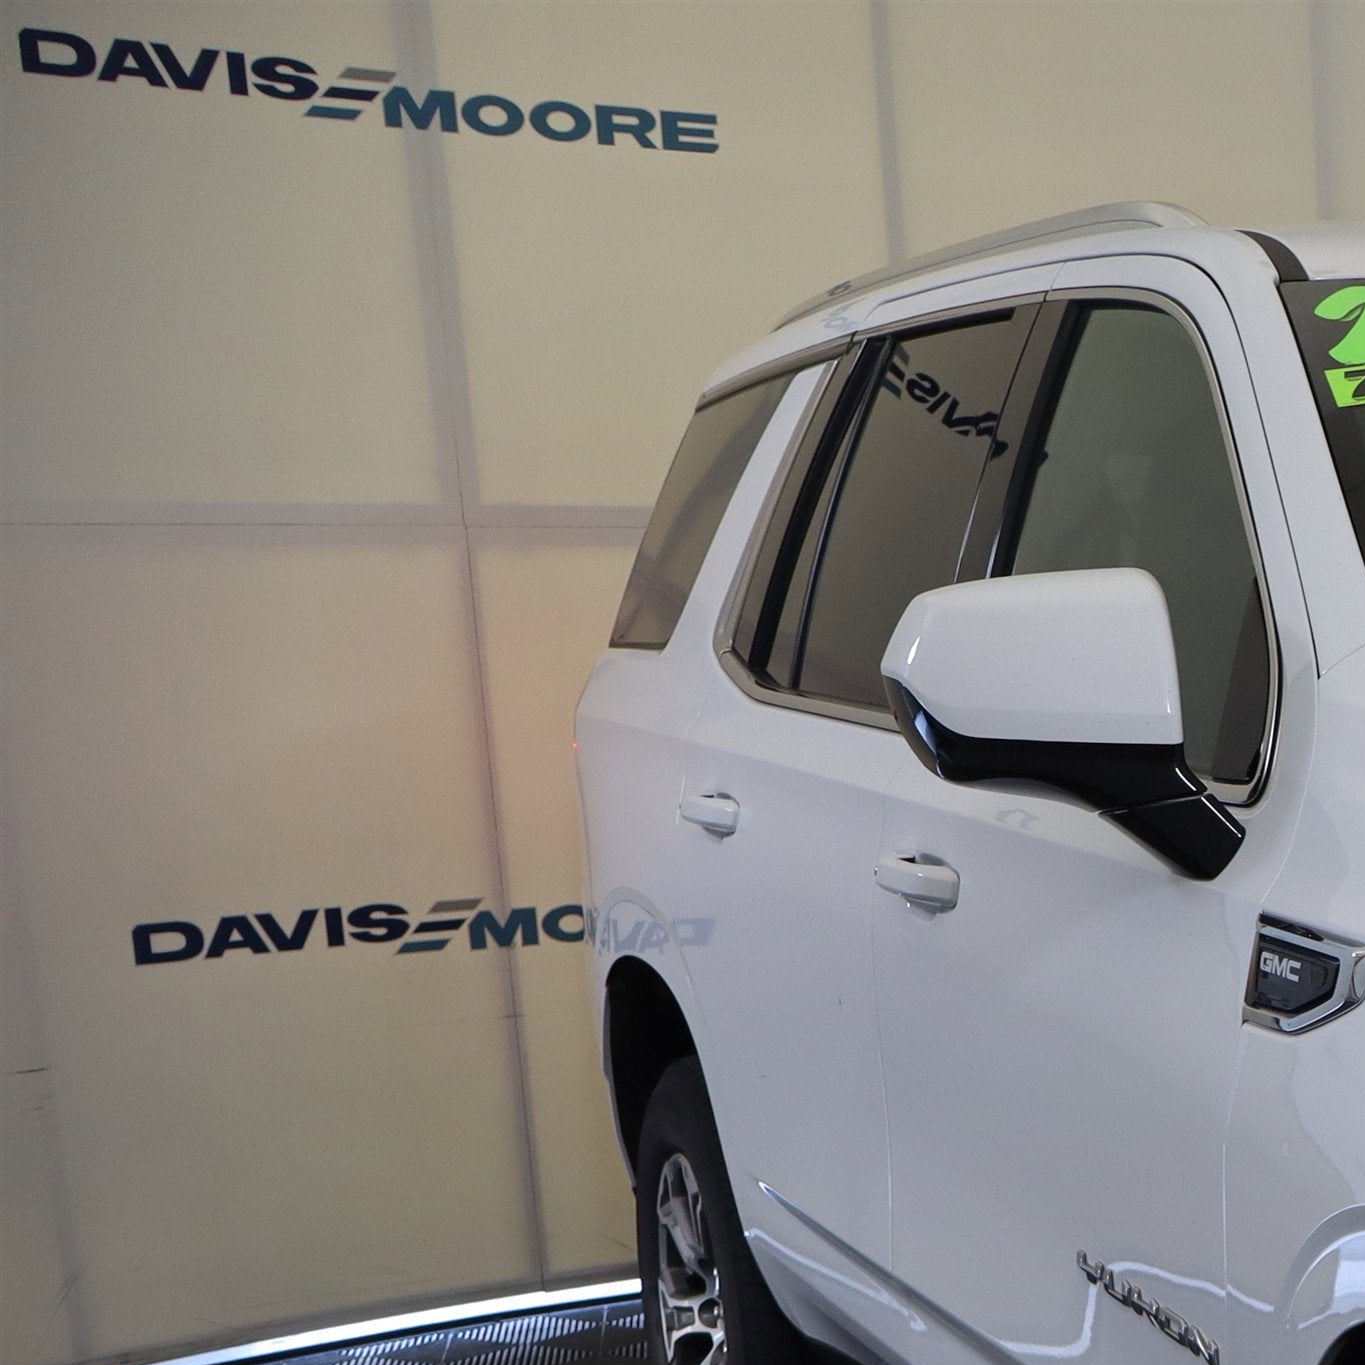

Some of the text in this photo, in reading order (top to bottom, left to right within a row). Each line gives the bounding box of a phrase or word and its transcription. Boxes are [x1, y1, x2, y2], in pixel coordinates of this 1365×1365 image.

[18, 27, 719, 153] DAVIS MOORE
[131, 903, 411, 966] DAVIS
[1260, 951, 1302, 983] GMC
